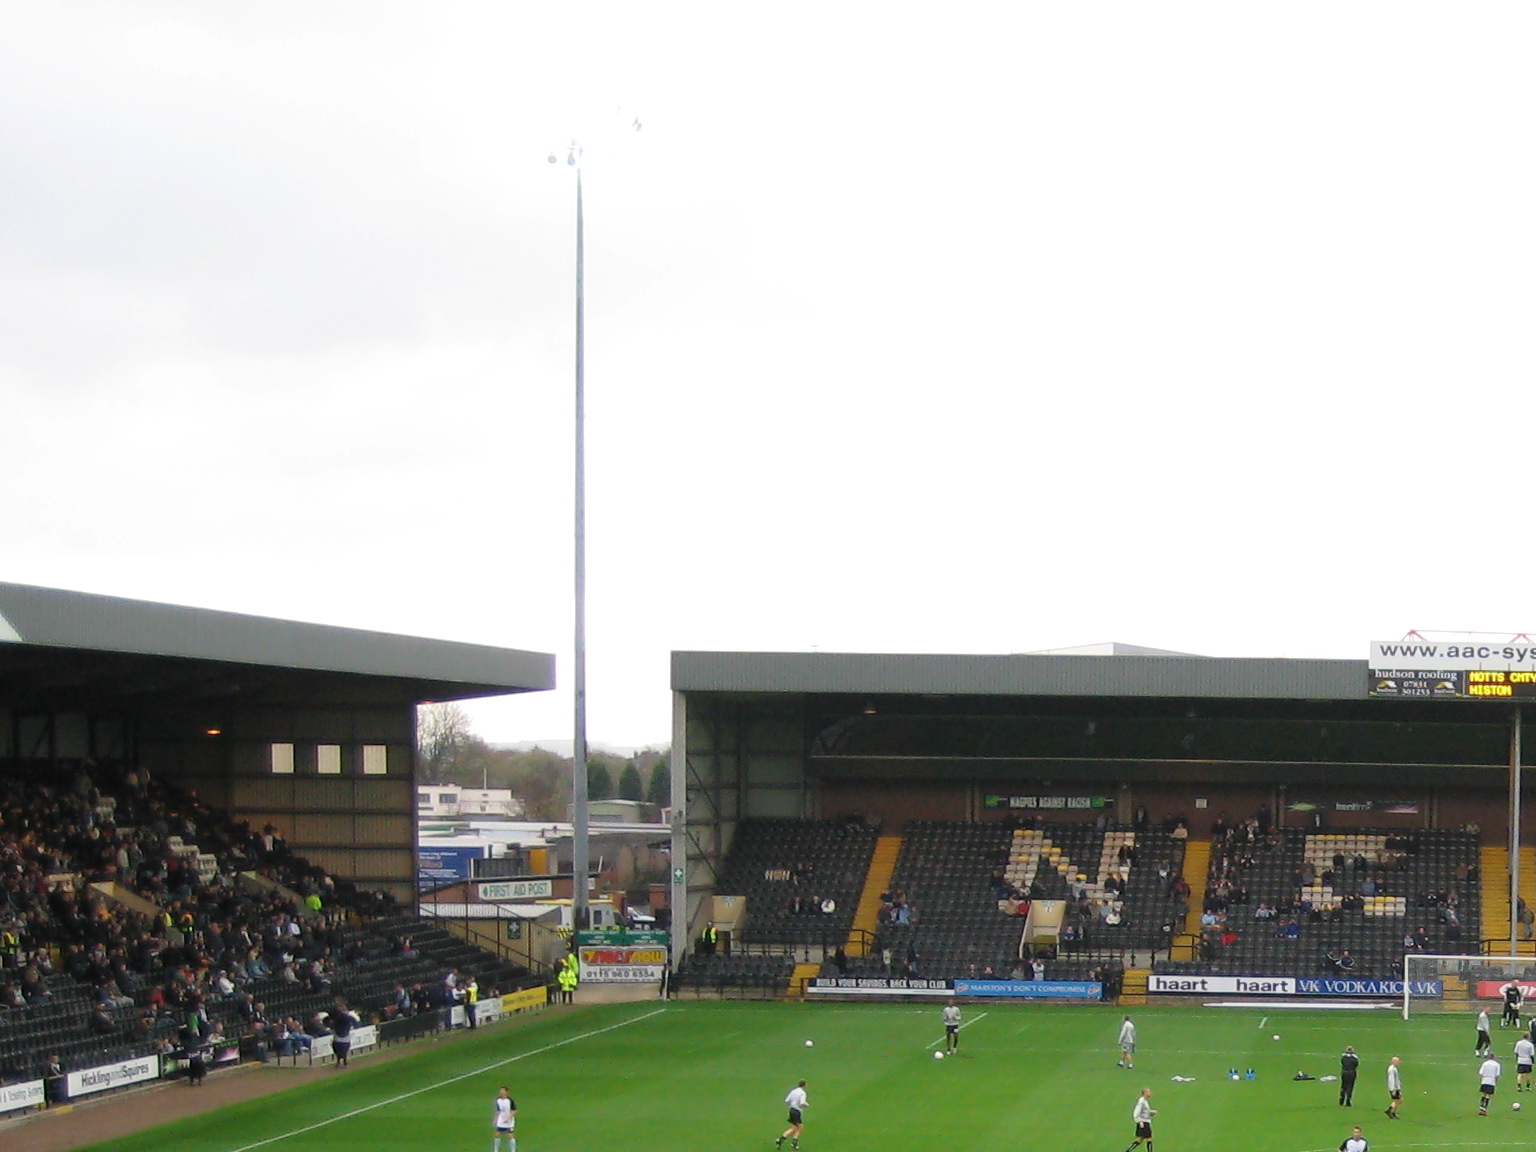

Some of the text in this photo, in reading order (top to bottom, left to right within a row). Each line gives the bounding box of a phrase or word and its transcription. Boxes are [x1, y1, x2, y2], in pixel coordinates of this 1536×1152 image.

[1375, 669, 1458, 681] hudson roofing
[1469, 671, 1505, 683] NOTTS
[1469, 684, 1512, 696] HISTON
[1038, 797, 1066, 808] AGAINST
[489, 882, 547, 897] FIRST AID POST
[816, 979, 836, 987] BUILD
[838, 979, 856, 988] YOUR
[890, 980, 907, 988] BACK
[909, 980, 927, 989] YOUR
[929, 980, 946, 989] CLUB
[1156, 978, 1288, 992] haart haart
[1299, 980, 1436, 994] VK VODKA KICK VK
